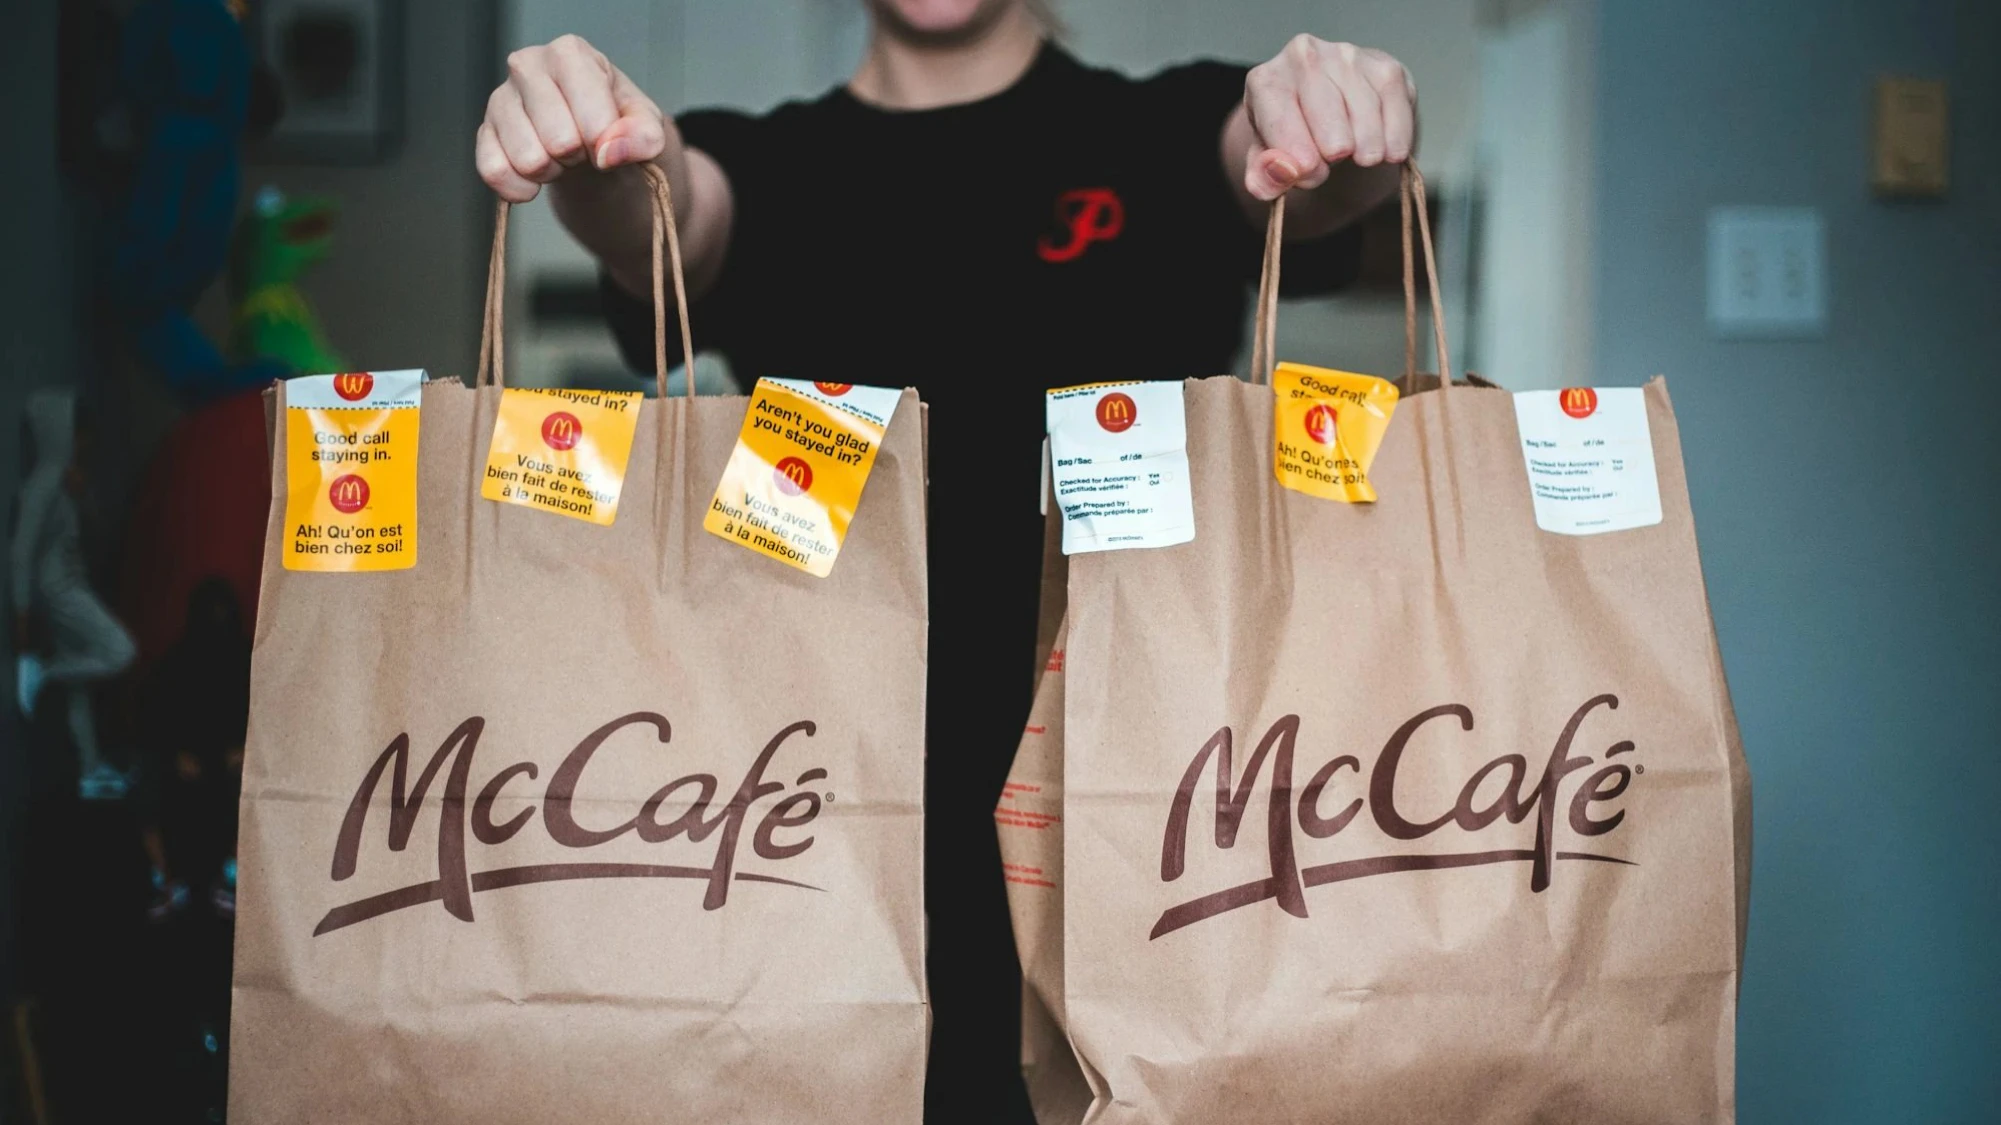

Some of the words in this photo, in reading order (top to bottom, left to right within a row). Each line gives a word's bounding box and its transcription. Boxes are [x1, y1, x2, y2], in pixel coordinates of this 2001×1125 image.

[1300, 376, 1339, 396] Good
[548, 388, 600, 406] stayed
[604, 396, 628, 412] in?
[756, 399, 803, 426] Aren't
[804, 420, 832, 440] you
[835, 432, 870, 454] glad
[314, 431, 357, 445] Good
[363, 431, 390, 444] call
[754, 415, 782, 434] you
[785, 428, 835, 457] stayed
[837, 447, 862, 466] in?
[311, 449, 369, 464] staying
[374, 448, 391, 460] in.
[1278, 442, 1297, 458] Ah!
[517, 454, 553, 474] Vous
[558, 466, 592, 483] avez
[1279, 458, 1302, 475] ien
[1306, 468, 1340, 484] chez
[487, 465, 518, 481] bien
[523, 473, 546, 488] fait
[549, 479, 568, 493] de
[571, 486, 615, 504] rester
[1060, 477, 1090, 487] Checked
[1092, 476, 1101, 484] for
[1104, 475, 1136, 484] Accuracy
[1060, 485, 1097, 495] Exactitude
[502, 485, 511, 497] à
[516, 487, 529, 500] la
[533, 493, 593, 516] maison!
[1065, 503, 1081, 513] Order
[1083, 501, 1115, 510] Prepared
[1117, 500, 1126, 508] by
[744, 493, 779, 517] Vous
[782, 510, 816, 533] avez
[1068, 509, 1102, 521] Commande
[1137, 507, 1149, 515] par
[296, 524, 322, 538] Ah!
[327, 524, 375, 539] Qu'on
[380, 524, 402, 537] est
[713, 498, 743, 520] bien
[746, 512, 770, 531] fait
[771, 522, 789, 539] de
[792, 530, 835, 557] rester
[295, 541, 328, 554] bien
[334, 542, 372, 555] chez
[377, 539, 403, 553] soi!
[724, 520, 733, 533] à
[737, 525, 750, 541] la
[753, 534, 810, 565] maison!
